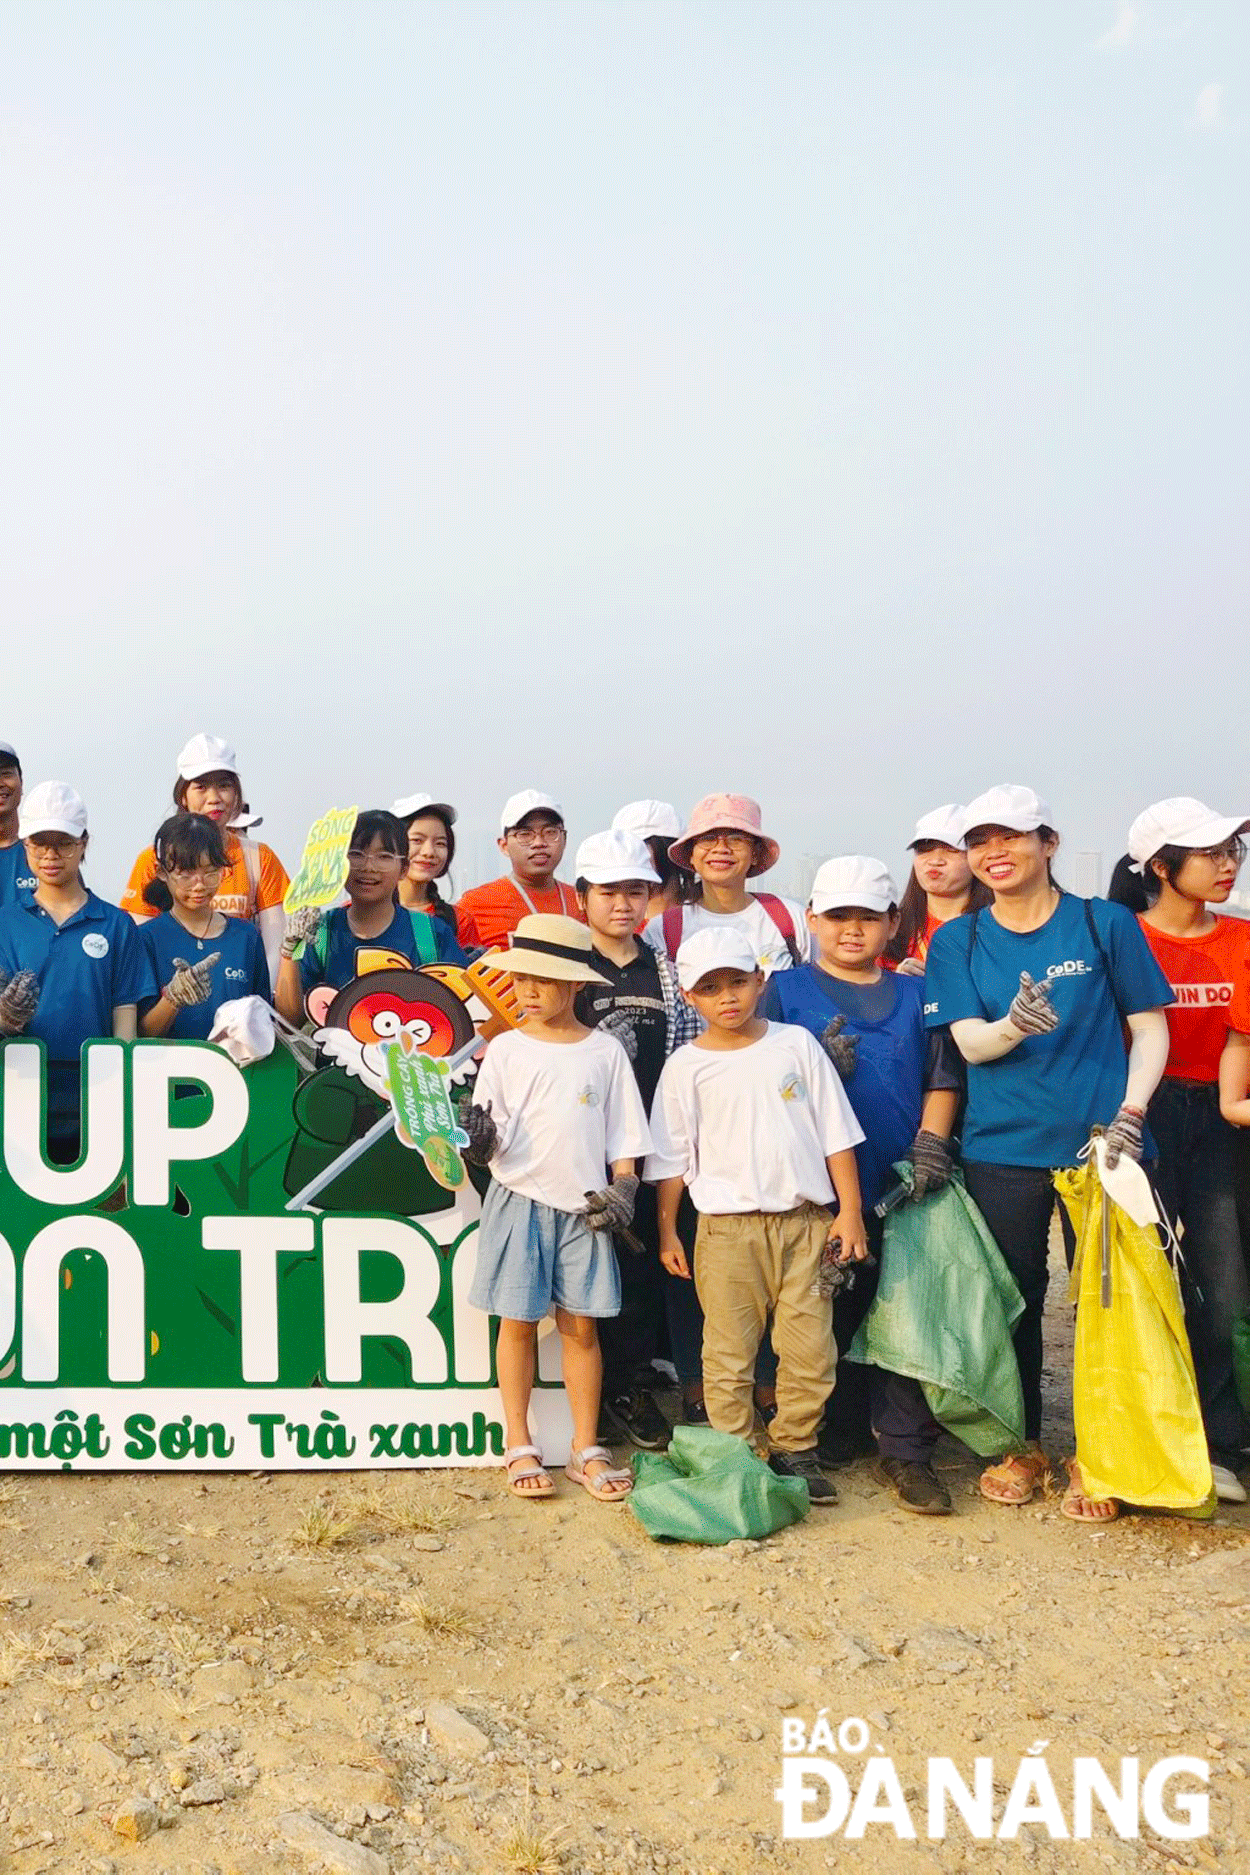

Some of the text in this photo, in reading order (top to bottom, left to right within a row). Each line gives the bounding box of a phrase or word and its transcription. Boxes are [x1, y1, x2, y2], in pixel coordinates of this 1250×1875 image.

[224, 967, 246, 979] CoD
[1046, 959, 1086, 977] CoDE
[1204, 984, 1233, 1002] DO
[624, 1007, 647, 1015] 2023
[2, 1043, 250, 1206] UP
[124, 1412, 234, 1460] Sơn
[248, 1409, 356, 1459] Trà
[368, 1411, 506, 1458] xanh
